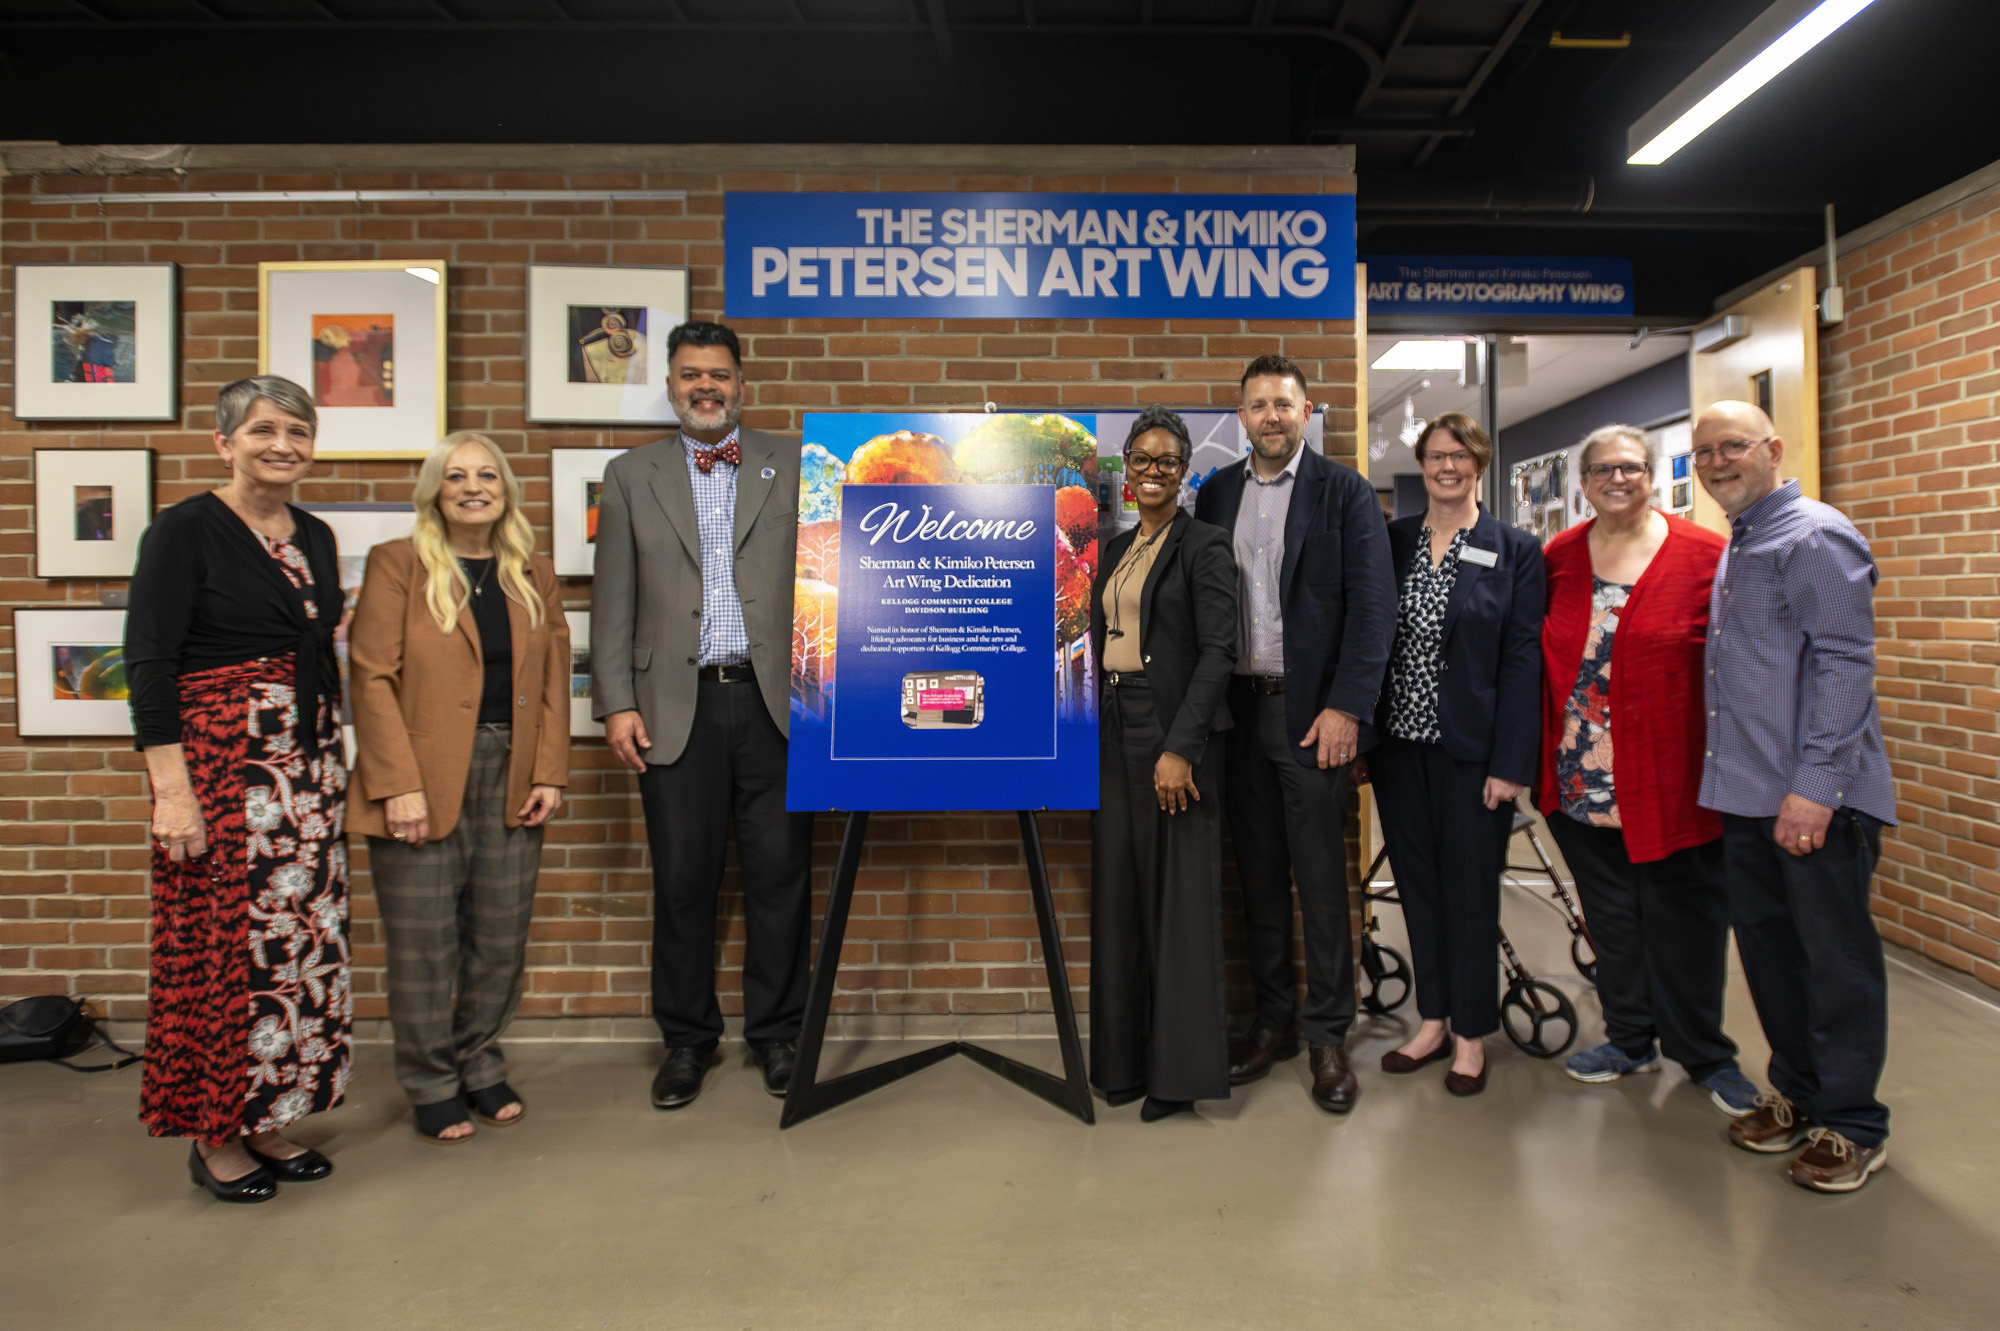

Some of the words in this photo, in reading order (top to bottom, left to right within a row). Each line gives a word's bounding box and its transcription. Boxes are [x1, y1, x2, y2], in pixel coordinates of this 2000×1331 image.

[856, 208, 933, 244] THE
[940, 208, 1138, 246] SHERMAN
[1143, 209, 1180, 246] &
[1185, 209, 1327, 247] KIMIKO
[751, 246, 1029, 298] PETERSEN
[1037, 247, 1152, 298] ART
[1157, 247, 1330, 299] WING
[1399, 266, 1420, 279] The
[1423, 266, 1475, 279] Sherman
[1478, 267, 1500, 279] and
[1367, 281, 1403, 301] ART
[1405, 281, 1423, 301] &
[1425, 282, 1566, 303] PHOTOGRAPHY
[1568, 283, 1626, 304] WING
[859, 502, 1037, 546] Welcome
[859, 556, 915, 570] Sherman
[917, 557, 931, 570] &
[934, 556, 983, 570] Kimiko
[984, 556, 1036, 570] Petersen
[883, 574, 905, 589] Art
[906, 574, 942, 592] Wing
[944, 574, 1012, 589] Dedication
[880, 598, 920, 606] KELLOGG
[921, 598, 973, 606] COMMUNITY
[974, 598, 1014, 606] COLLEGE
[904, 606, 946, 615] DAVIDSON
[948, 606, 989, 615] BUILDING
[867, 625, 891, 634] Named
[892, 625, 899, 634] in
[900, 625, 920, 634] honor
[921, 625, 929, 634] of
[928, 625, 958, 634] Sherman
[958, 626, 966, 634] &
[966, 625, 992, 634] Kimiko
[870, 635, 895, 645] lifelong
[896, 635, 926, 643] advocates
[928, 635, 938, 643] for
[938, 635, 965, 643] business
[966, 635, 979, 643] and
[980, 635, 990, 643] the
[991, 635, 1004, 643] arts
[1004, 634, 1018, 643] and
[860, 644, 891, 653] dedicated
[892, 645, 926, 655] supporters
[926, 644, 935, 653] of
[935, 644, 961, 655] Kellogg
[961, 644, 1000, 655] Community
